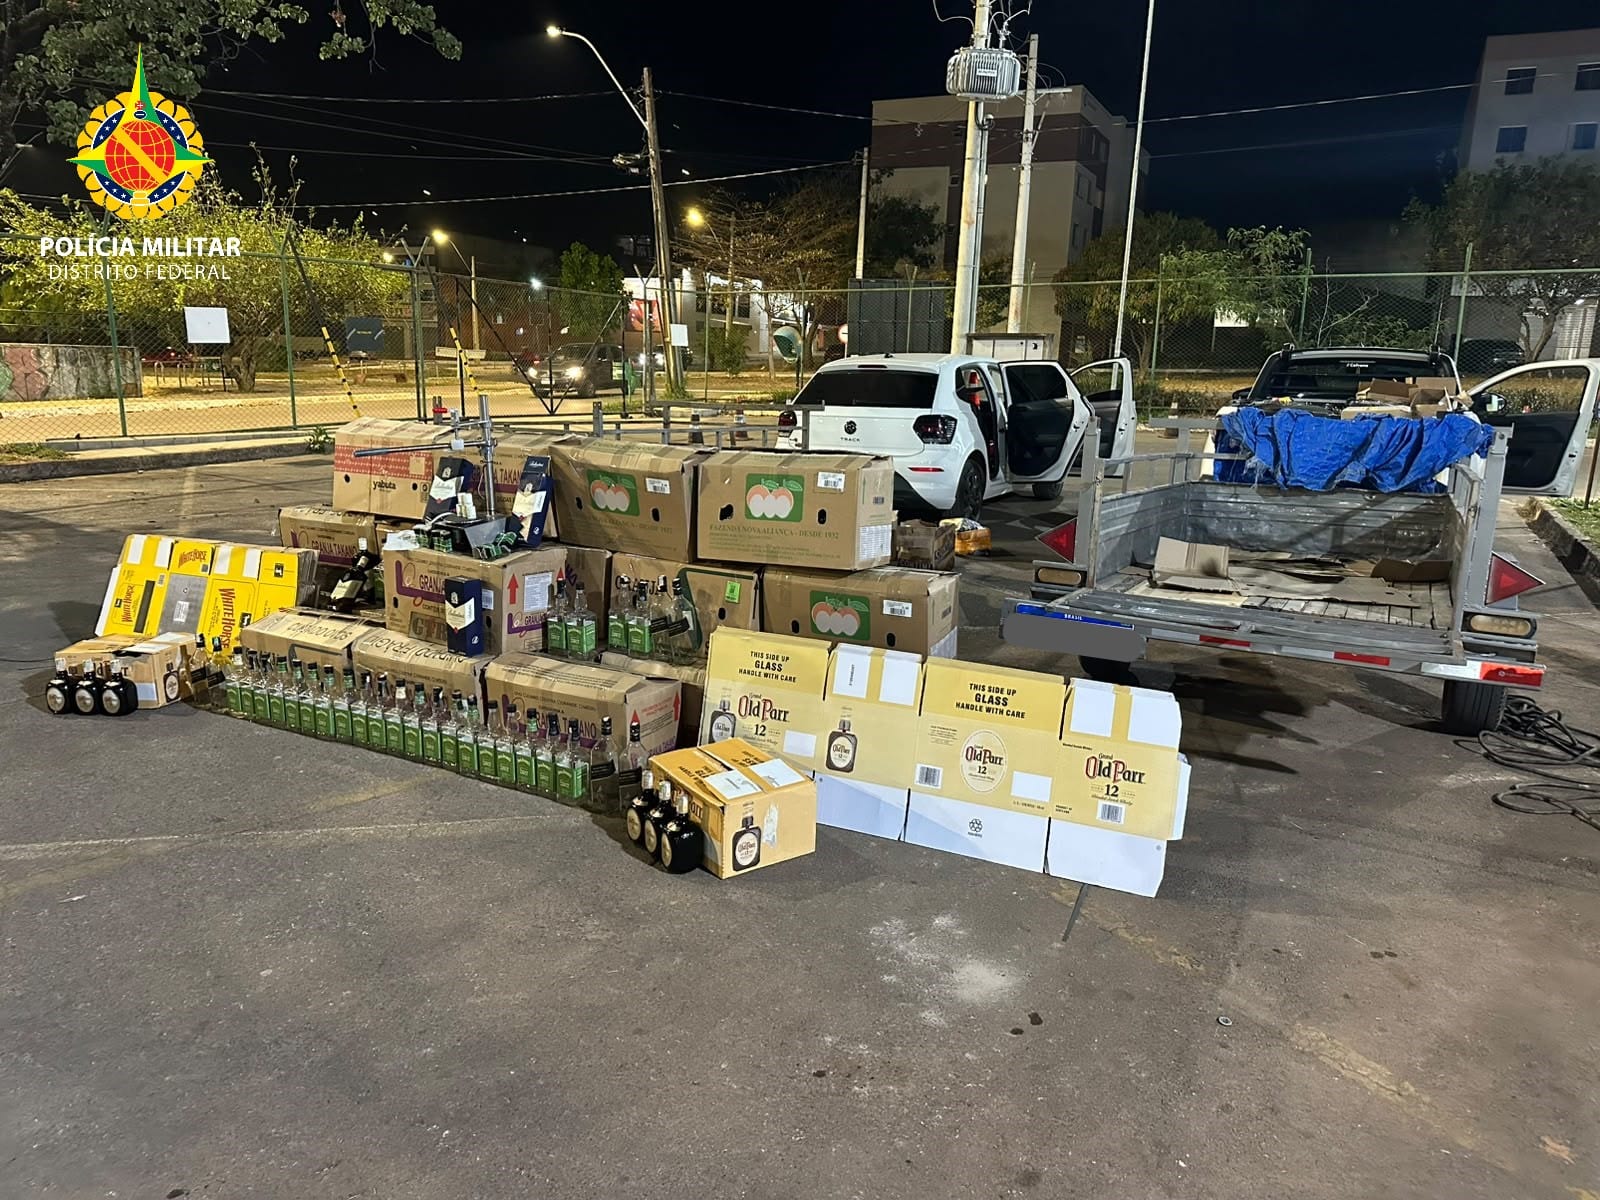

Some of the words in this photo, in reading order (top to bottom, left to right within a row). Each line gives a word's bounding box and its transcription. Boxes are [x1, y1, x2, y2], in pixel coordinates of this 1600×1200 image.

[372, 479, 397, 490] yabuta
[709, 524, 741, 533] FAZENDA
[742, 526, 762, 534] NOVA
[799, 530, 821, 538] DESDE
[219, 588, 235, 619] WHITE
[219, 616, 236, 649] HORSE
[750, 651, 764, 659] THIS
[765, 652, 779, 661] SIDE
[754, 660, 783, 672] GLASS
[739, 668, 762, 678] HANDLE
[763, 672, 779, 680] WITH
[780, 674, 797, 683] CARE
[969, 683, 986, 692] THIS
[987, 686, 1005, 694] SIDE
[1006, 688, 1017, 696] UP
[974, 693, 1008, 706] GLASS
[738, 695, 761, 719] Old
[761, 698, 790, 722] Parr
[955, 702, 984, 713] HANDLE
[985, 706, 1004, 716] WITH
[1006, 709, 1026, 719] CARE
[754, 724, 767, 736] 12
[965, 746, 982, 762] Old
[982, 748, 1004, 766] Parr
[977, 765, 987, 775] 12
[1085, 756, 1112, 779] Old
[1112, 760, 1146, 784] Parr
[1104, 784, 1119, 797] 12
